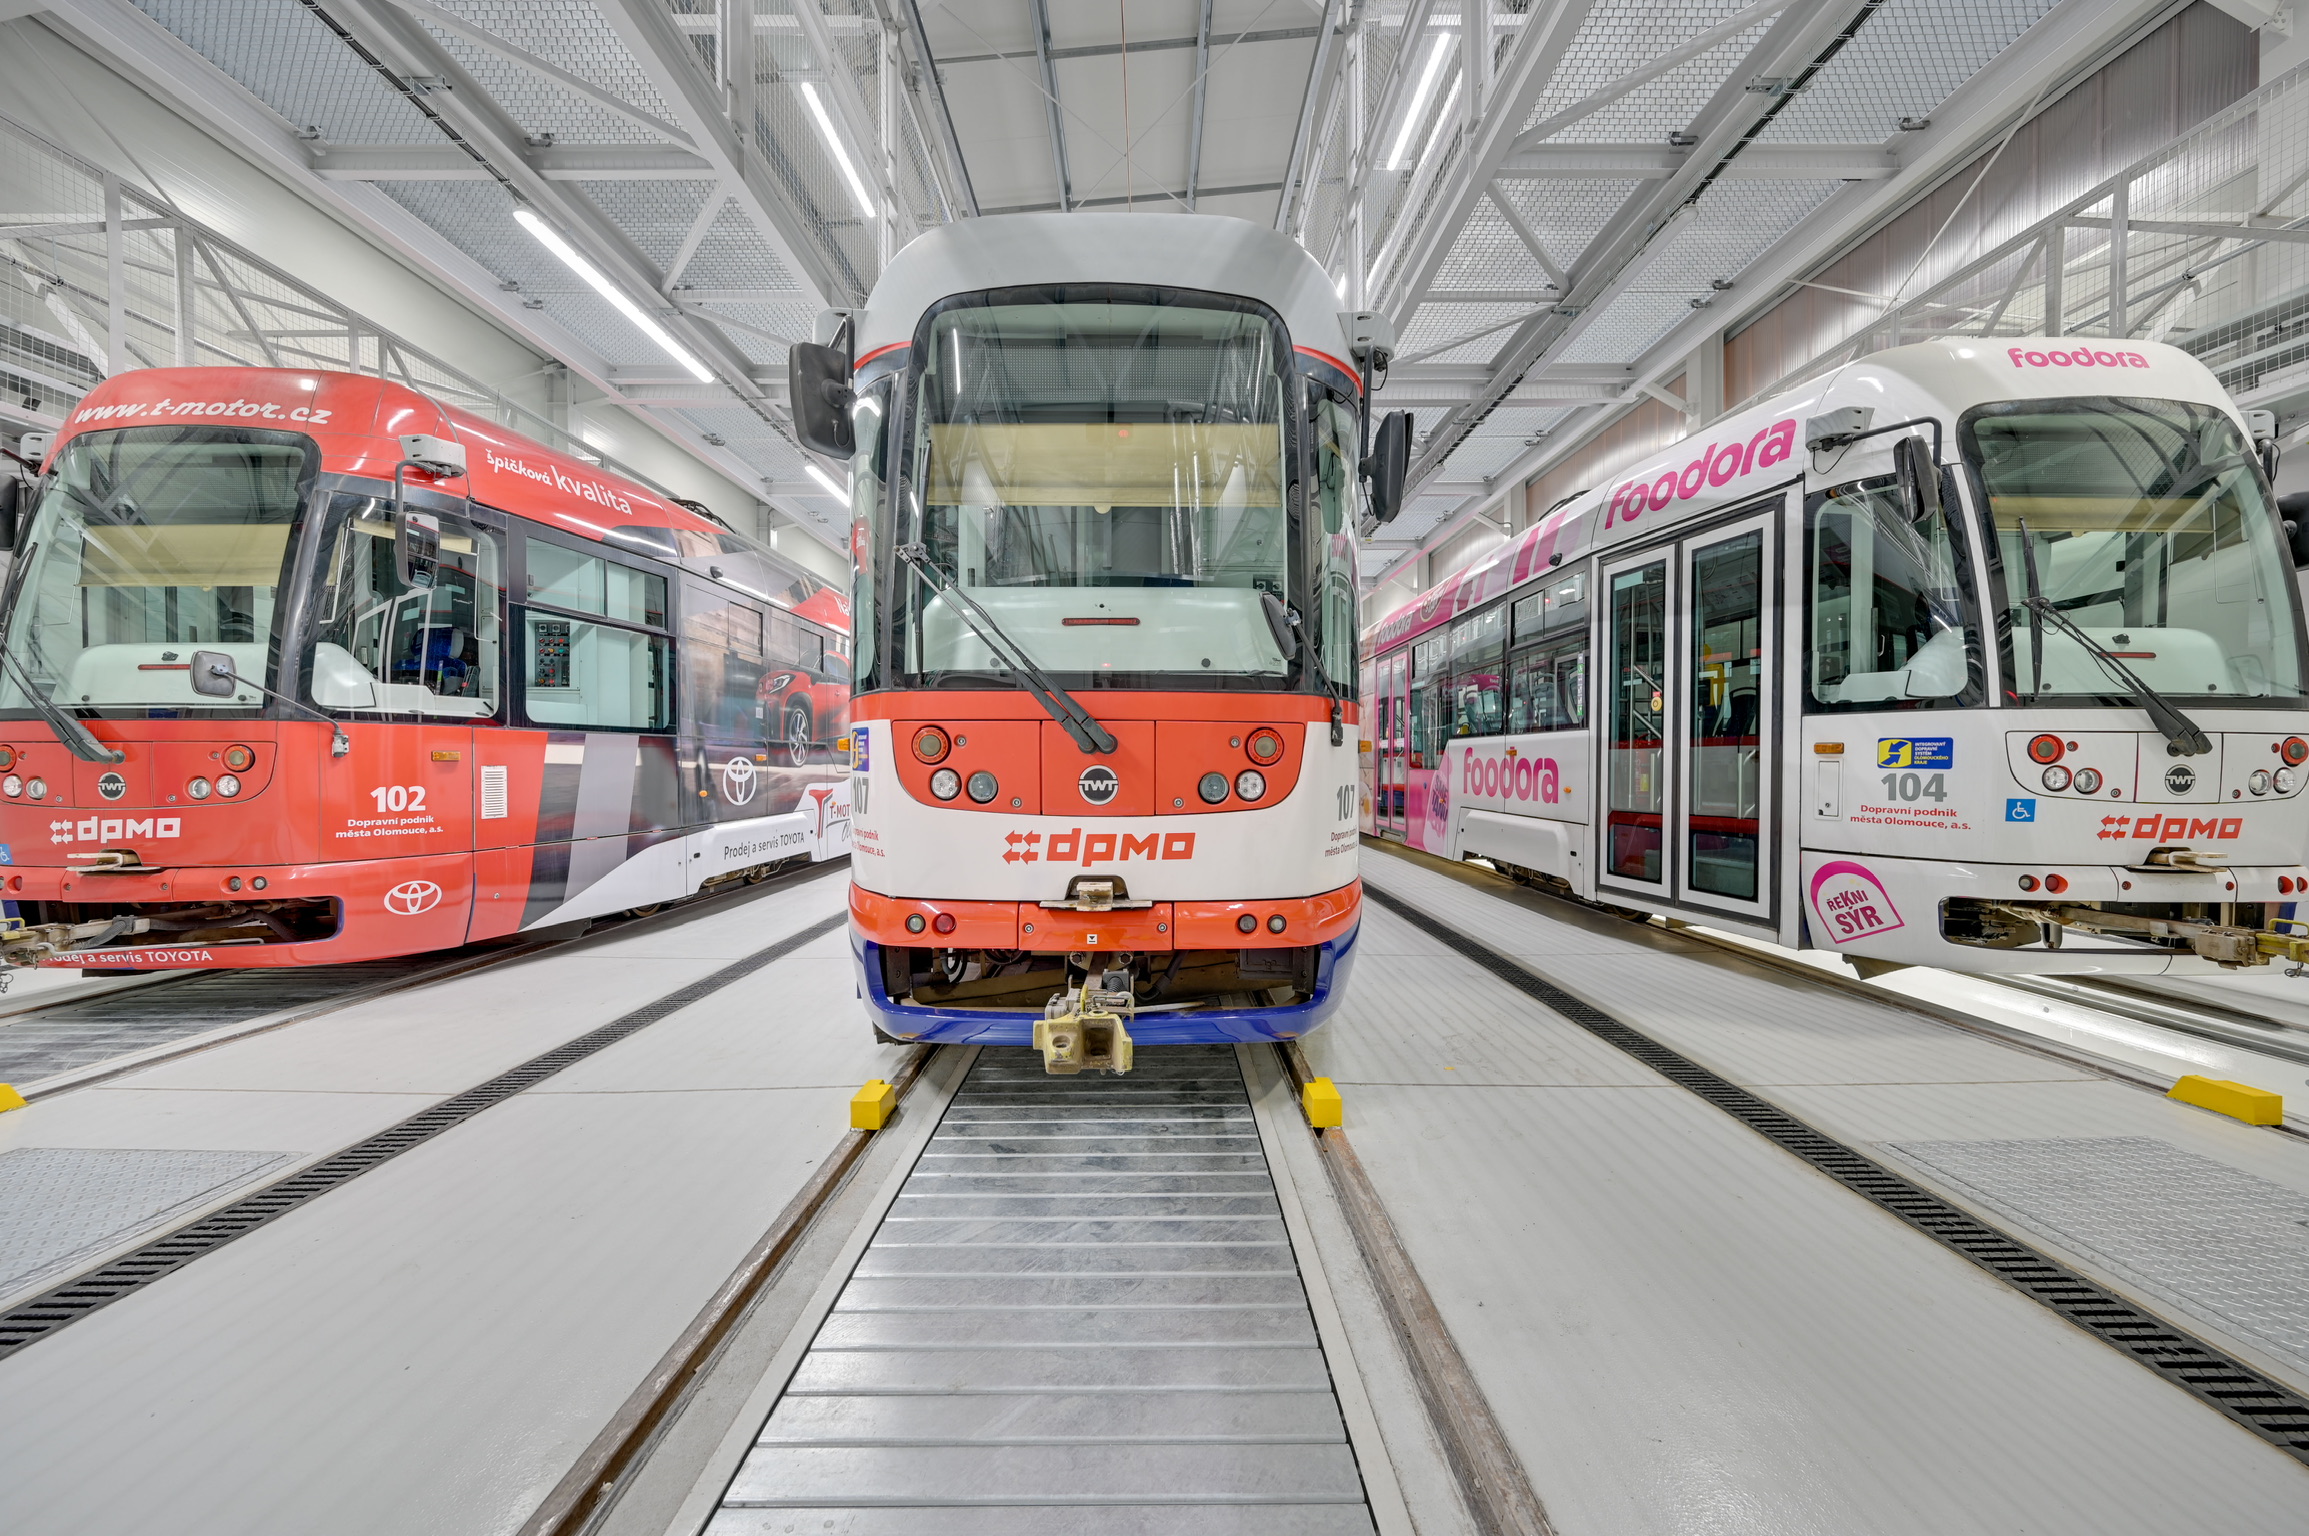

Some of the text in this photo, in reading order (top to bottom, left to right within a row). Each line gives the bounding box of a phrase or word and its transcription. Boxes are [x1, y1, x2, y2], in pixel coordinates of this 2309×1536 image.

[2007, 347, 2150, 369] foodora
[74, 398, 332, 424] www.t-motor.cz
[485, 448, 633, 515] špičková kvalita
[1605, 418, 1797, 530] foodora
[1463, 747, 1559, 804] foodora
[1881, 772, 1947, 802] 104
[370, 785, 427, 812] 102
[853, 776, 869, 815] 107
[1336, 784, 1355, 821] 107
[347, 815, 435, 828] Dopravní podnik
[1850, 815, 1882, 824] města
[1884, 817, 1948, 830] Olomouce,
[1860, 805, 1958, 817] Dopravní podnik
[335, 829, 371, 838] města
[373, 827, 428, 837] Olomouce,
[724, 832, 805, 860] Prodej a servis TOYOTA
[1826, 890, 1869, 911] ŘEKNI
[1835, 905, 1884, 934] SÝR
[87, 954, 96, 963] a
[99, 951, 143, 963] servis
[145, 950, 213, 962] TOYOTA
